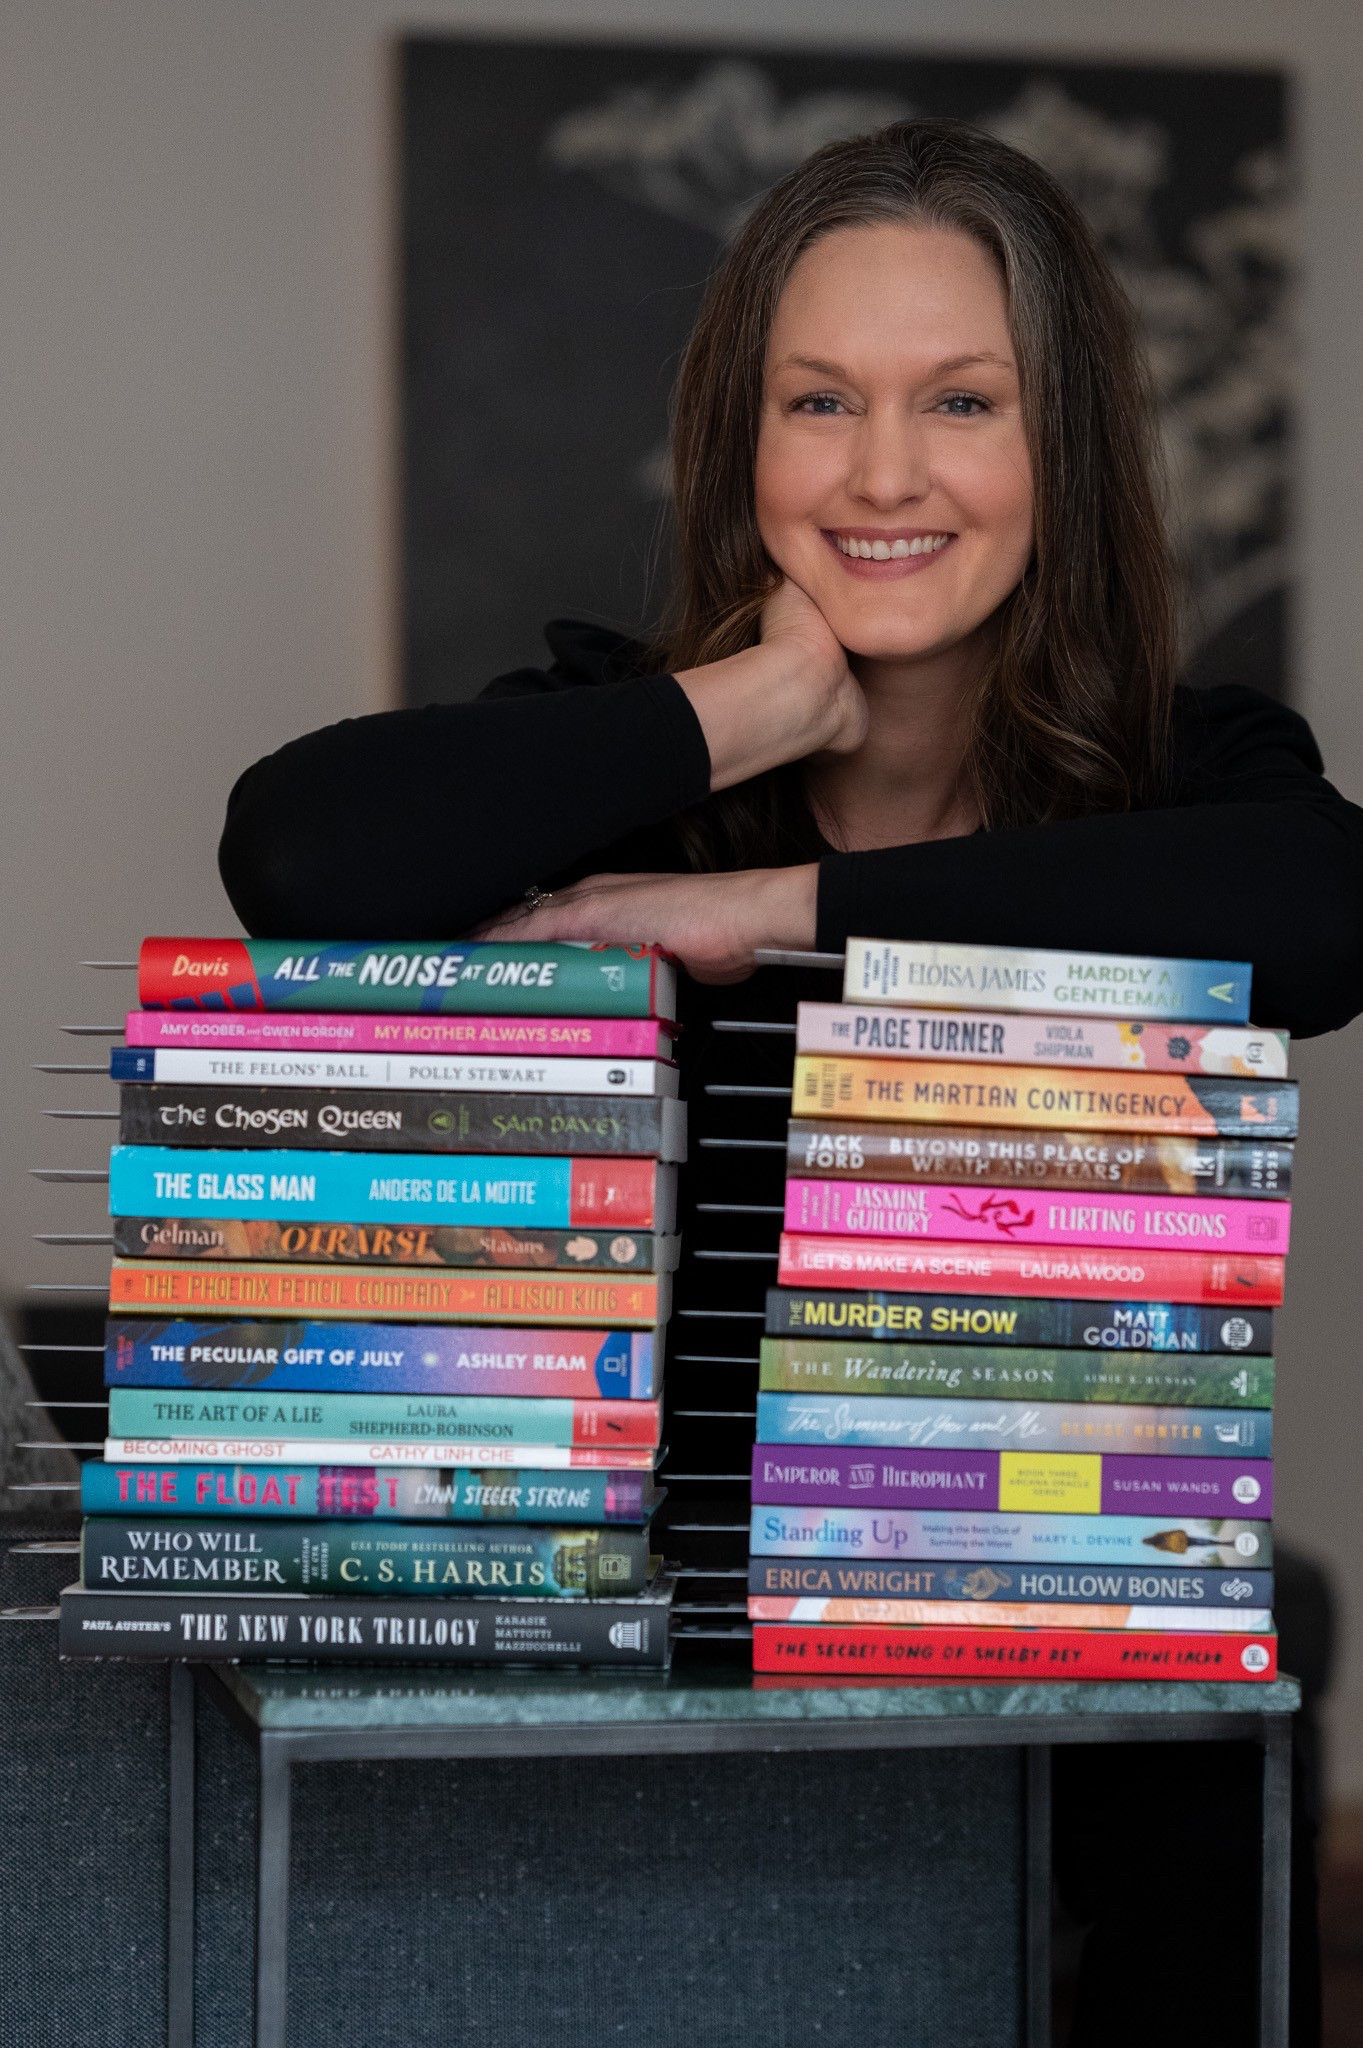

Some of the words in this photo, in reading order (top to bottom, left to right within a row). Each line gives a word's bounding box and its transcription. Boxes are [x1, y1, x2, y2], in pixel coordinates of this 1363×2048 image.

[171, 954, 230, 977] Davis
[273, 955, 320, 981] ALL
[327, 962, 356, 978] THE
[358, 954, 464, 987] NOISE
[460, 964, 485, 981] AT
[486, 962, 558, 987] ONCE
[908, 962, 976, 988] ELOISA
[979, 966, 1046, 992] JAMES
[1067, 963, 1153, 984] HARDLY
[1158, 970, 1173, 985] A
[1053, 984, 1184, 1009] GENTLEMAN
[160, 1023, 189, 1036] AMY
[263, 1025, 300, 1037] GWEN
[374, 1026, 401, 1039] MY
[404, 1026, 476, 1041] MOTHER
[479, 1027, 547, 1042] ALWAYS
[550, 1028, 592, 1043] SAYS
[831, 1022, 850, 1038] THE
[854, 1016, 911, 1049] PAGE
[917, 1019, 1006, 1054] TURNER
[1044, 1025, 1084, 1042] VIOLA
[1033, 1041, 1094, 1059] SHIPMAN
[209, 1061, 244, 1075] THE
[326, 1063, 369, 1078] BALL
[409, 1066, 463, 1080] POLLY
[468, 1067, 547, 1082] STEWART
[865, 1079, 904, 1102] THE
[914, 1082, 1017, 1108] MARTIAN
[1027, 1087, 1188, 1117] CONTINGENCY
[807, 1134, 863, 1153] JACK
[889, 1138, 980, 1157] BEYOND
[987, 1142, 1037, 1160] THIS
[1043, 1143, 1109, 1163] PLACE
[1116, 1146, 1145, 1164] OF
[805, 1151, 865, 1169] FORD
[1055, 1161, 1121, 1181] TEARS
[153, 1172, 192, 1199] THE
[198, 1173, 264, 1200] GLASS
[270, 1174, 316, 1201] MAN
[369, 1178, 433, 1202] ANDERS
[437, 1179, 458, 1202] DE
[461, 1180, 481, 1203] LA
[485, 1181, 536, 1205] MOTTE
[851, 1186, 929, 1211] JASMINE
[846, 1209, 933, 1233] GUILLORY
[1048, 1204, 1137, 1234] FLIRTING
[1144, 1210, 1228, 1239] LESSONS
[140, 1223, 224, 1247] Gelman
[803, 1254, 852, 1271] LET'S
[856, 1255, 909, 1273] MAKE
[911, 1258, 926, 1274] A
[929, 1259, 992, 1277] SCENE
[1020, 1263, 1085, 1280] LAURA
[1084, 1264, 1145, 1283] WOOD
[145, 1274, 181, 1299] THE
[187, 1276, 271, 1302] PHOENIX
[278, 1278, 347, 1304] PENCIL
[355, 1280, 452, 1306] COMPANY
[483, 1284, 565, 1310] ALLISON
[572, 1286, 618, 1311] KING
[789, 1299, 804, 1326] THE
[804, 1301, 923, 1330] MURDER
[930, 1307, 1018, 1335] SHOW
[1113, 1309, 1169, 1329] MATT
[1083, 1327, 1197, 1351] GOLDMAN
[150, 1345, 185, 1362] THE
[190, 1346, 279, 1364] PECULIAR
[283, 1348, 325, 1366] GIFT
[329, 1349, 356, 1366] OF
[360, 1350, 404, 1368] JULY
[456, 1353, 527, 1370] ASHLEY
[533, 1354, 586, 1371] REAM
[791, 1360, 834, 1377] THE
[844, 1357, 963, 1389] Wandering
[971, 1366, 1055, 1383] SEASON
[153, 1403, 194, 1421] THE
[199, 1404, 239, 1422] ART
[242, 1405, 268, 1423] OF
[272, 1406, 290, 1423] A
[291, 1406, 323, 1424] LIE
[406, 1404, 457, 1418] LAURA
[350, 1421, 514, 1438] SHEPHERD-ROBINSON
[123, 1441, 218, 1456] BECOMING
[223, 1442, 286, 1458] GHOST
[369, 1445, 427, 1460] CATHY
[434, 1446, 473, 1462] LINH
[477, 1448, 514, 1463] CHE
[116, 1470, 178, 1503] THE
[196, 1473, 302, 1506] FLOAT
[319, 1476, 400, 1509] TEST
[414, 1484, 458, 1504] LYNN
[463, 1485, 522, 1507] STEGER
[525, 1487, 591, 1508] STRONG
[1112, 1478, 1162, 1493] SUSAN
[1167, 1480, 1221, 1495] WANDS
[126, 1530, 193, 1551] WHO
[196, 1531, 264, 1553] WILL
[764, 1515, 863, 1548] Standing
[871, 1519, 908, 1549] Up
[100, 1555, 287, 1584] REMEMBER
[339, 1557, 369, 1583] C.
[377, 1559, 403, 1584] S.
[413, 1560, 546, 1587] HARRIS
[765, 1567, 833, 1591] ERICA
[838, 1569, 935, 1593] WRIGHT
[1020, 1574, 1123, 1598] HOLLOW
[1128, 1576, 1204, 1599] BONES
[82, 1620, 114, 1630] PAUL
[114, 1620, 172, 1632] AUSTER'S
[180, 1613, 228, 1641] THE
[238, 1614, 288, 1642] NEW
[299, 1615, 363, 1644] YORK
[373, 1616, 480, 1647] TRILOGY
[495, 1615, 547, 1626] KARASIK
[776, 1642, 806, 1657] THE
[816, 1643, 878, 1658] SECRET
[885, 1643, 933, 1659] SONG
[943, 1644, 964, 1659] OF
